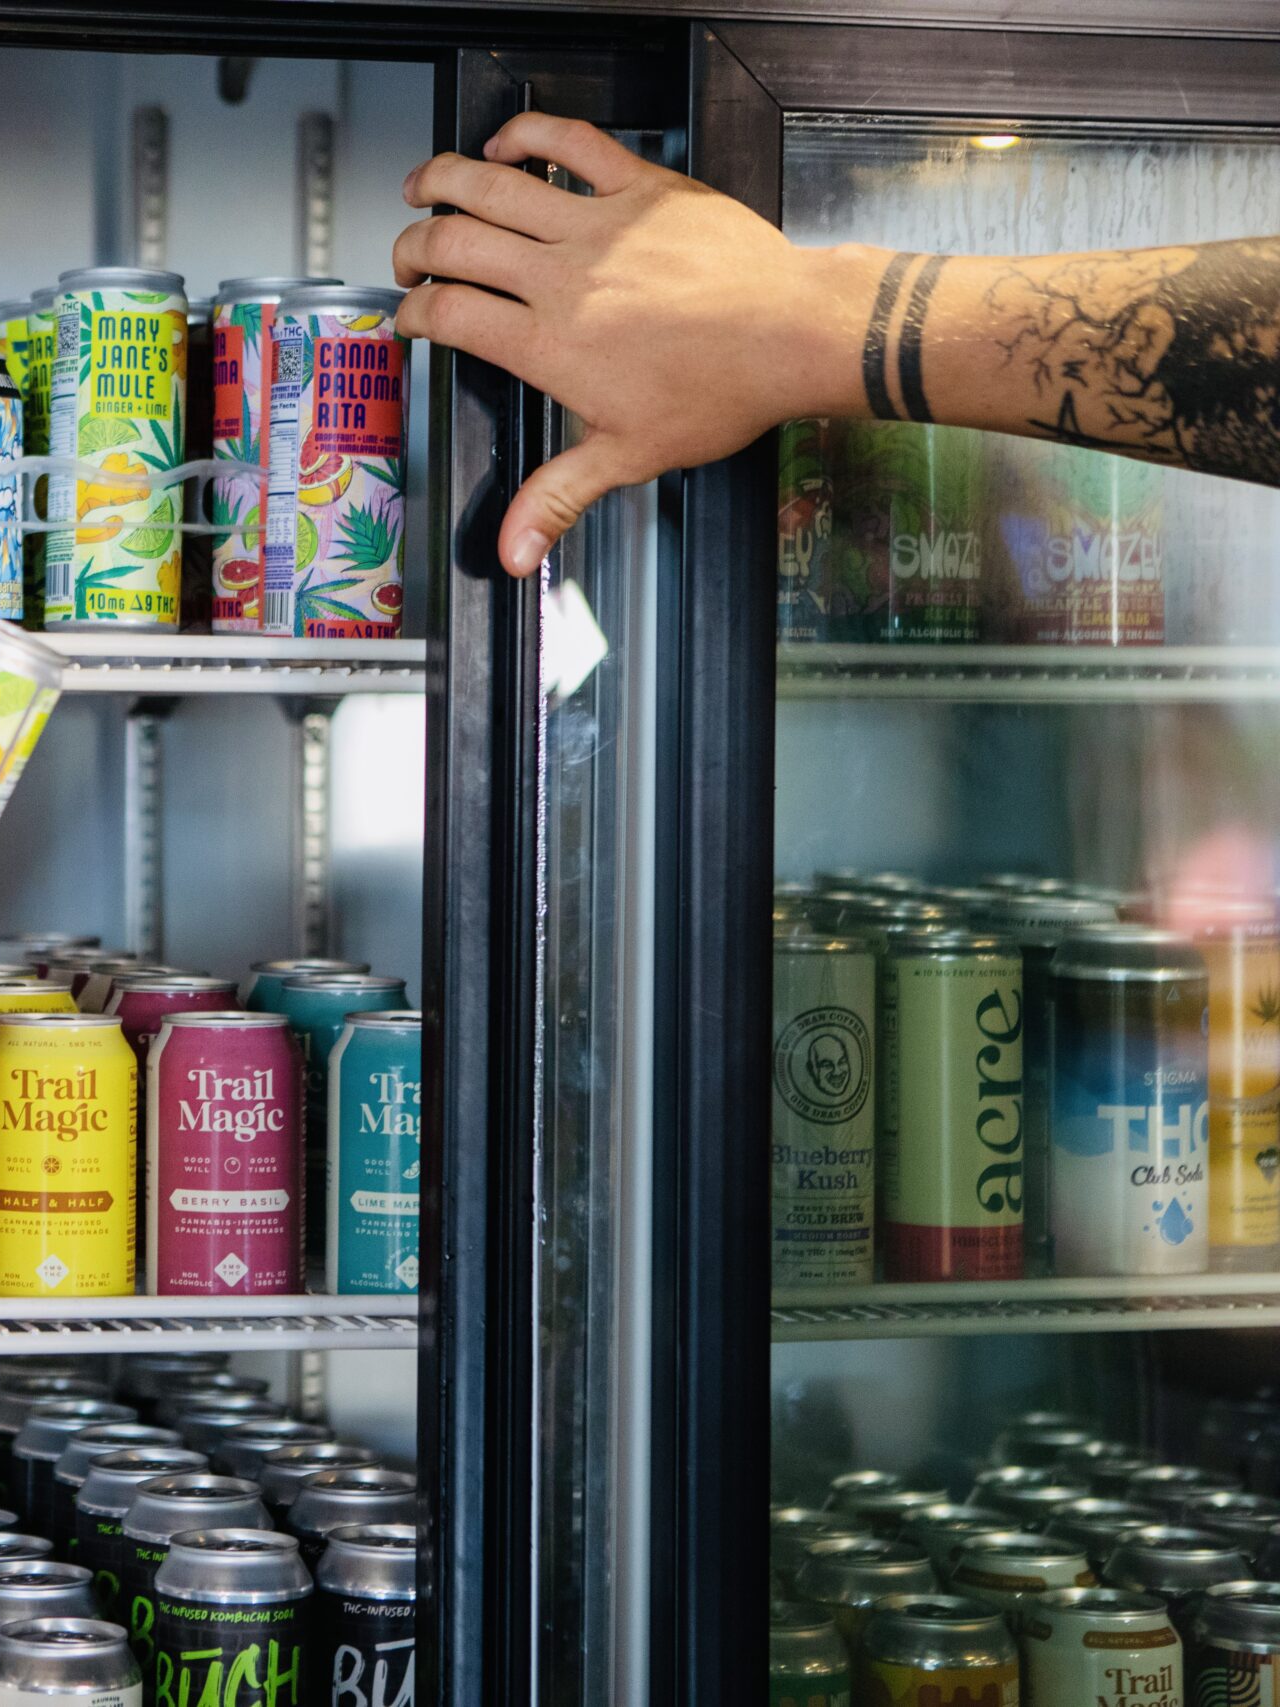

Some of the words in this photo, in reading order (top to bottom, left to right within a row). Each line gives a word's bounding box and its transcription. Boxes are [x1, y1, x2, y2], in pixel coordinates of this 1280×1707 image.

[98, 316, 160, 341] MARY
[284, 327, 302, 337] THC
[96, 345, 168, 372] JANE'S
[320, 342, 388, 370] CANNA
[97, 373, 155, 400] MULE
[318, 372, 399, 401] PALOMA
[96, 401, 133, 414] GINGER
[146, 404, 167, 417] LIME
[317, 403, 366, 429] RITA
[315, 433, 355, 443] GRAPEFRUIT
[157, 595, 174, 614] THC
[11, 1068, 98, 1101] Trail
[188, 1068, 274, 1101] Trail
[976, 988, 1023, 1215] acre
[1, 1101, 108, 1143] Magic
[178, 1101, 284, 1143] Magic
[797, 1169, 858, 1190] Kush
[1131, 1164, 1171, 1187] Club
[1175, 1164, 1203, 1186] Soda
[4, 1197, 39, 1207] HALF
[49, 1199, 57, 1207] &
[68, 1197, 105, 1207] HALF
[182, 1197, 230, 1206] BERRY
[240, 1197, 280, 1206] BASIL
[358, 1199, 386, 1208] LIME
[4, 1219, 102, 1227] CANNABIS-INFUSED
[181, 1218, 278, 1226] CANNABIS-INFUSED
[786, 1213, 827, 1224] COLD
[831, 1212, 864, 1224] BREW
[175, 1227, 230, 1235] SPARKLING
[236, 1227, 283, 1235] BEVERAGE
[356, 1228, 410, 1237] SPARKLING
[170, 1279, 213, 1287] ALCOHOLIC
[136, 1549, 150, 1560] THC
[160, 1601, 171, 1613] THC
[172, 1604, 208, 1620] INFUSED
[210, 1611, 270, 1623] KOMBUCHA
[273, 1608, 294, 1622] SODA
[343, 1602, 410, 1618] THC-INFUSED
[1105, 1664, 1173, 1695] Trail
